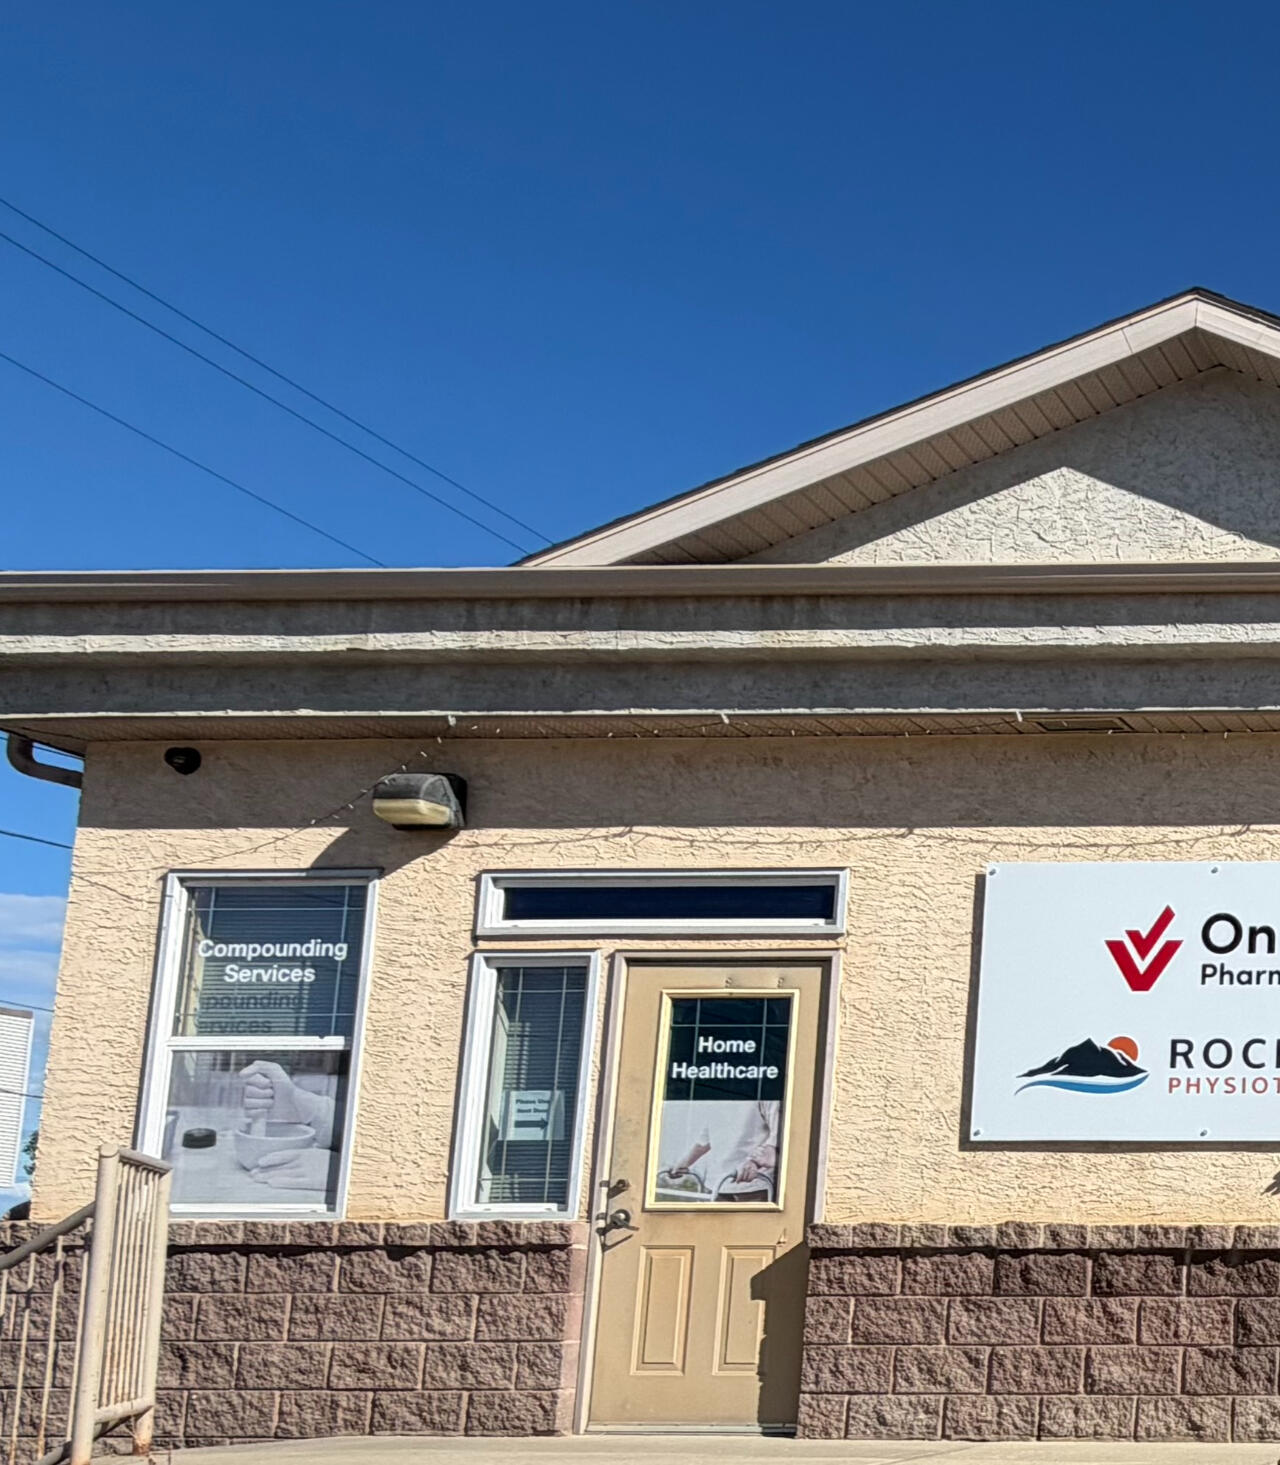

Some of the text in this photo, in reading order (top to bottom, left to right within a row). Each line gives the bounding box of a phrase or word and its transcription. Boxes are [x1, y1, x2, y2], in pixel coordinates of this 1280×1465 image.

[1201, 912, 1276, 954] On
[198, 939, 348, 961] Compounding
[223, 964, 316, 983] Services
[697, 1036, 757, 1054] Home
[671, 1062, 779, 1079] Healthcare
